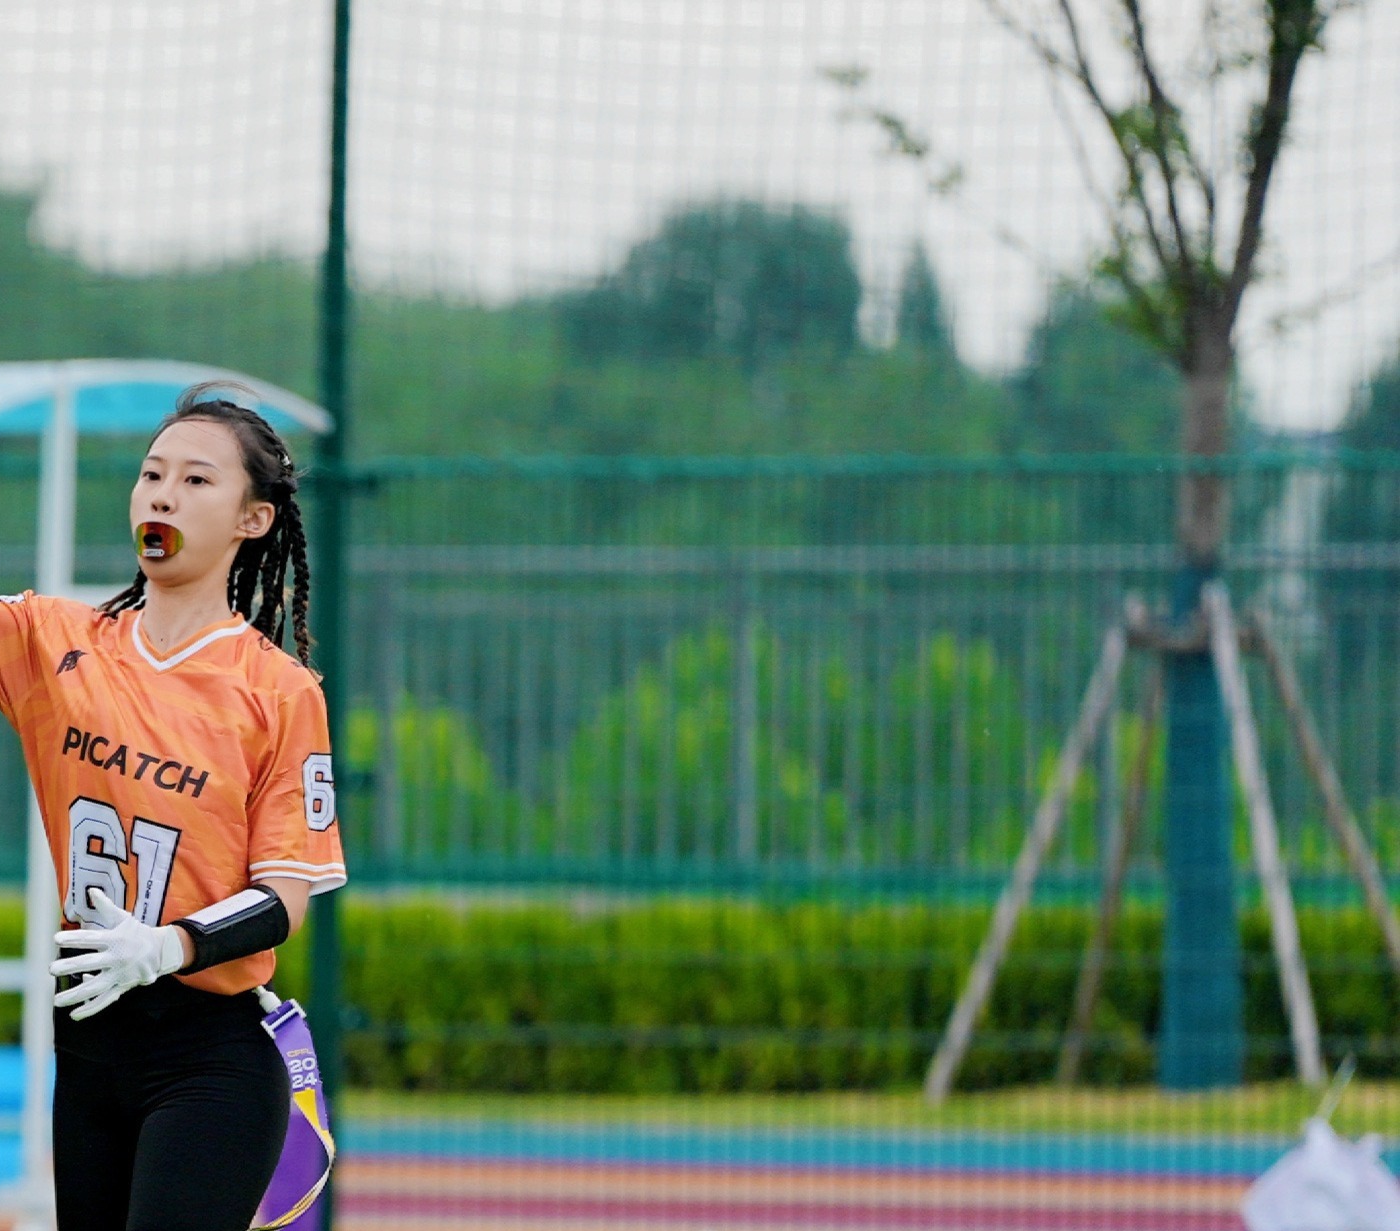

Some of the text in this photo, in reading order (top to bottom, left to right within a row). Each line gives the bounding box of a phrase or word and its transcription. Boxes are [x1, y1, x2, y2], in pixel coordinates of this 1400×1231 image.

[61, 725, 211, 799] PICATCH
[63, 795, 182, 928] 61
[287, 1056, 316, 1074] 20
[291, 1071, 318, 1089] 24
